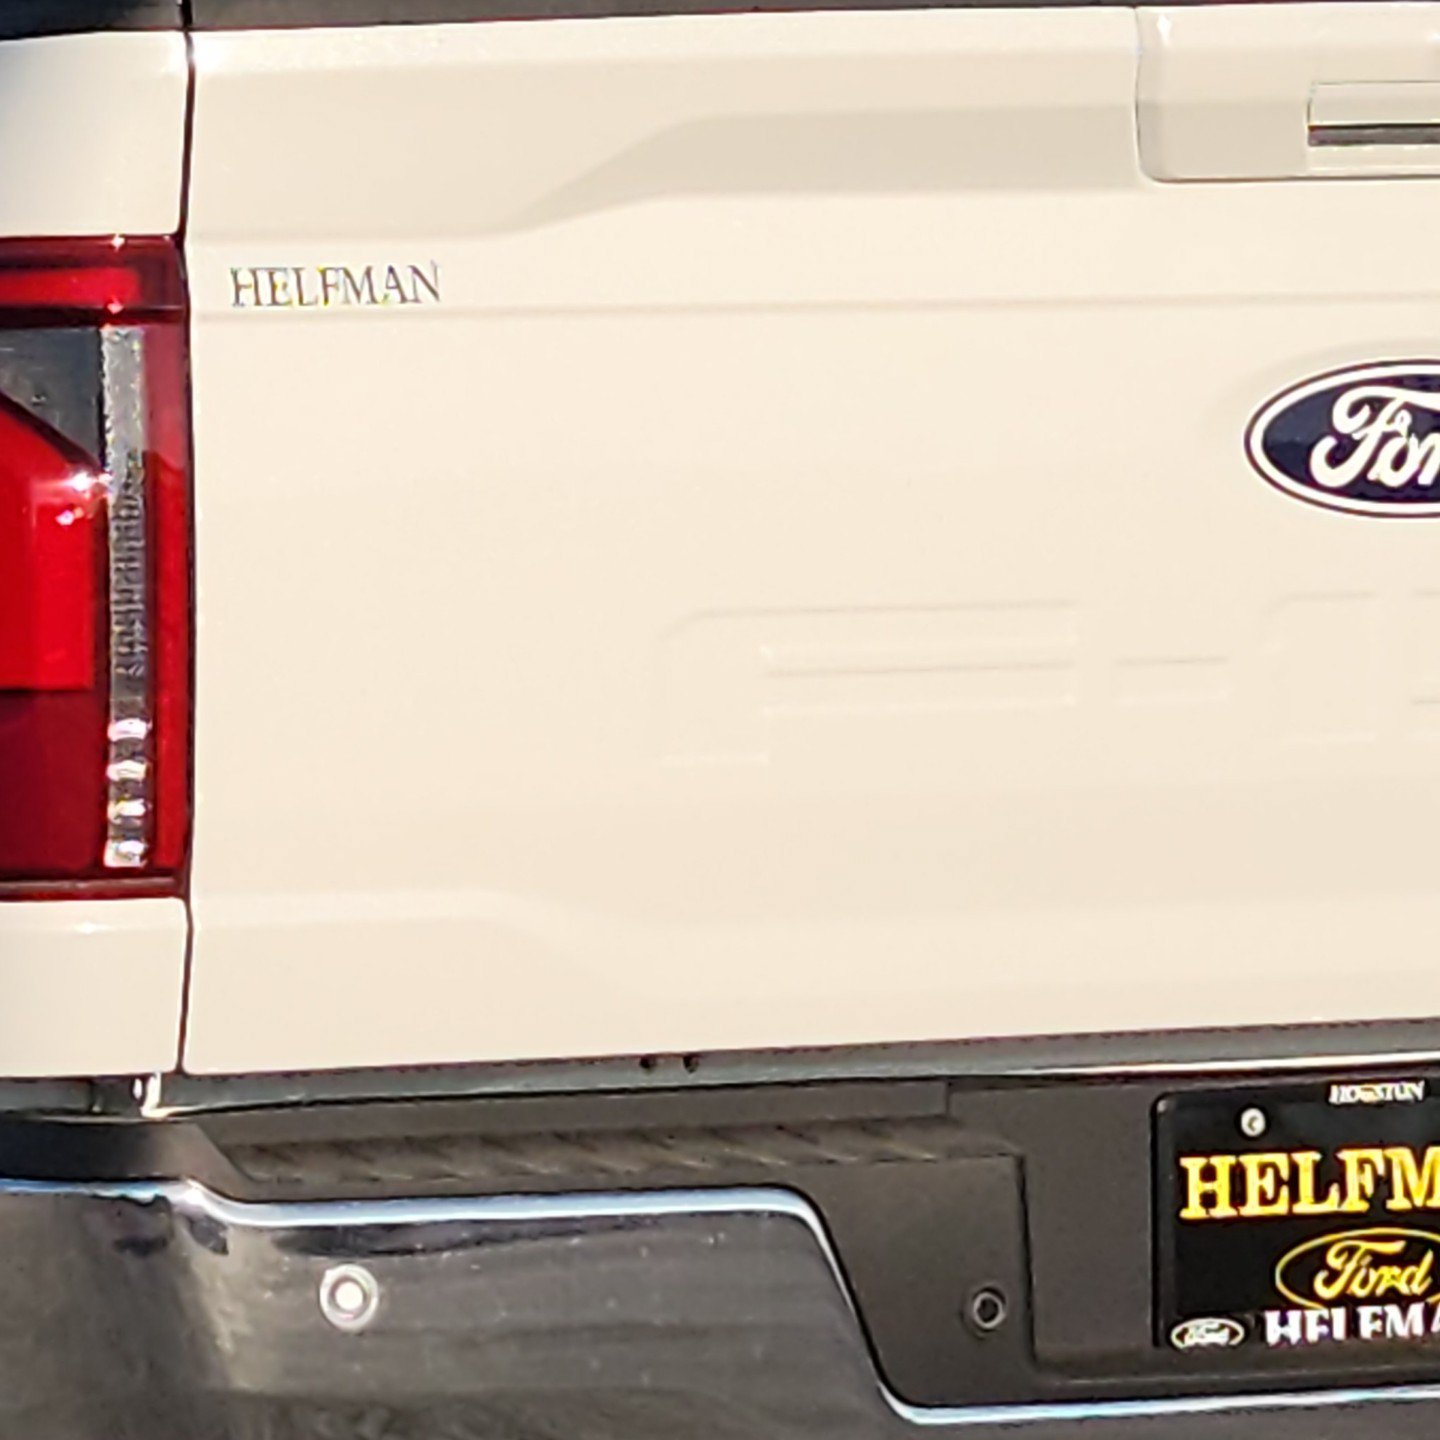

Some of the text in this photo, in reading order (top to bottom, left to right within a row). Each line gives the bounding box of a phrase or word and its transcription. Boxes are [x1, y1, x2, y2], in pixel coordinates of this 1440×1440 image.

[230, 260, 441, 307] HELFMAN
[1328, 1079, 1426, 1105] HOUSTON
[1313, 1239, 1434, 1300] Ford
